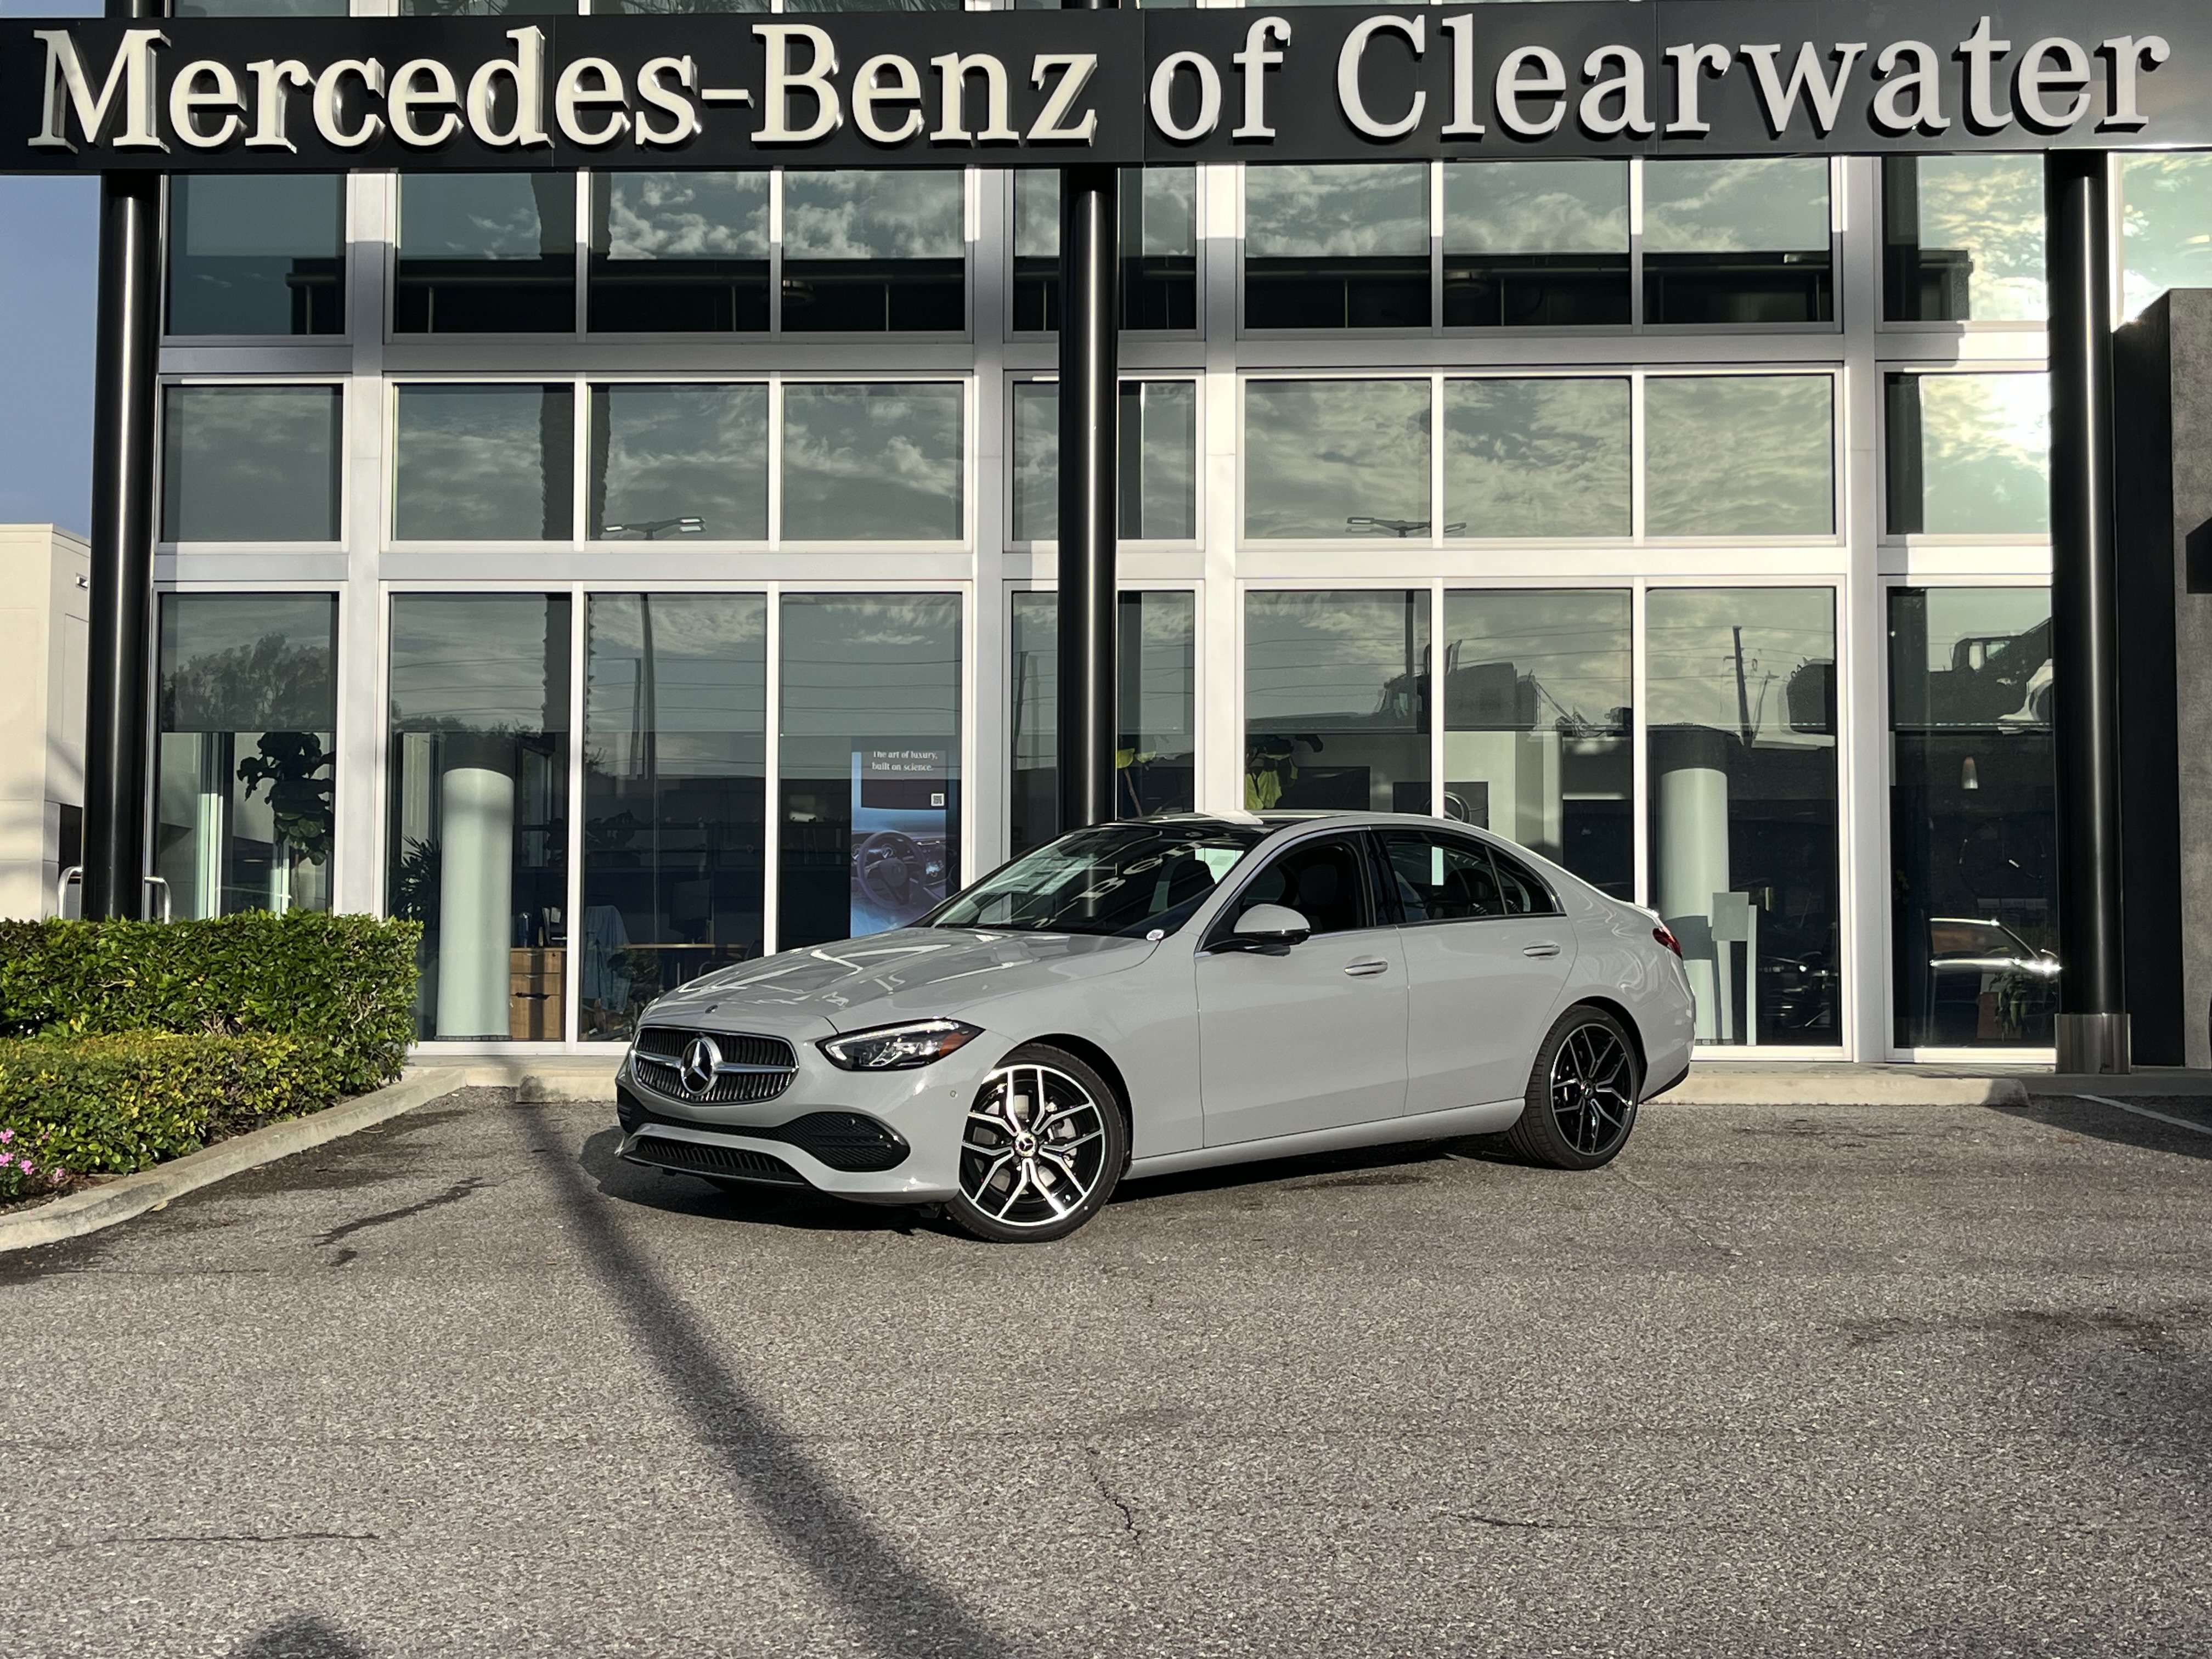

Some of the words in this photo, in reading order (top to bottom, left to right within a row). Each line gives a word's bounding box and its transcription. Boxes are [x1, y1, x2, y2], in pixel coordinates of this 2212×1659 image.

[28, 24, 1098, 149] Mercedes-Benz
[1149, 16, 1292, 140] of
[1338, 14, 2171, 138] Clearwater
[911, 751, 938, 760] luxury,
[872, 761, 890, 770] built
[903, 763, 934, 771] science.
